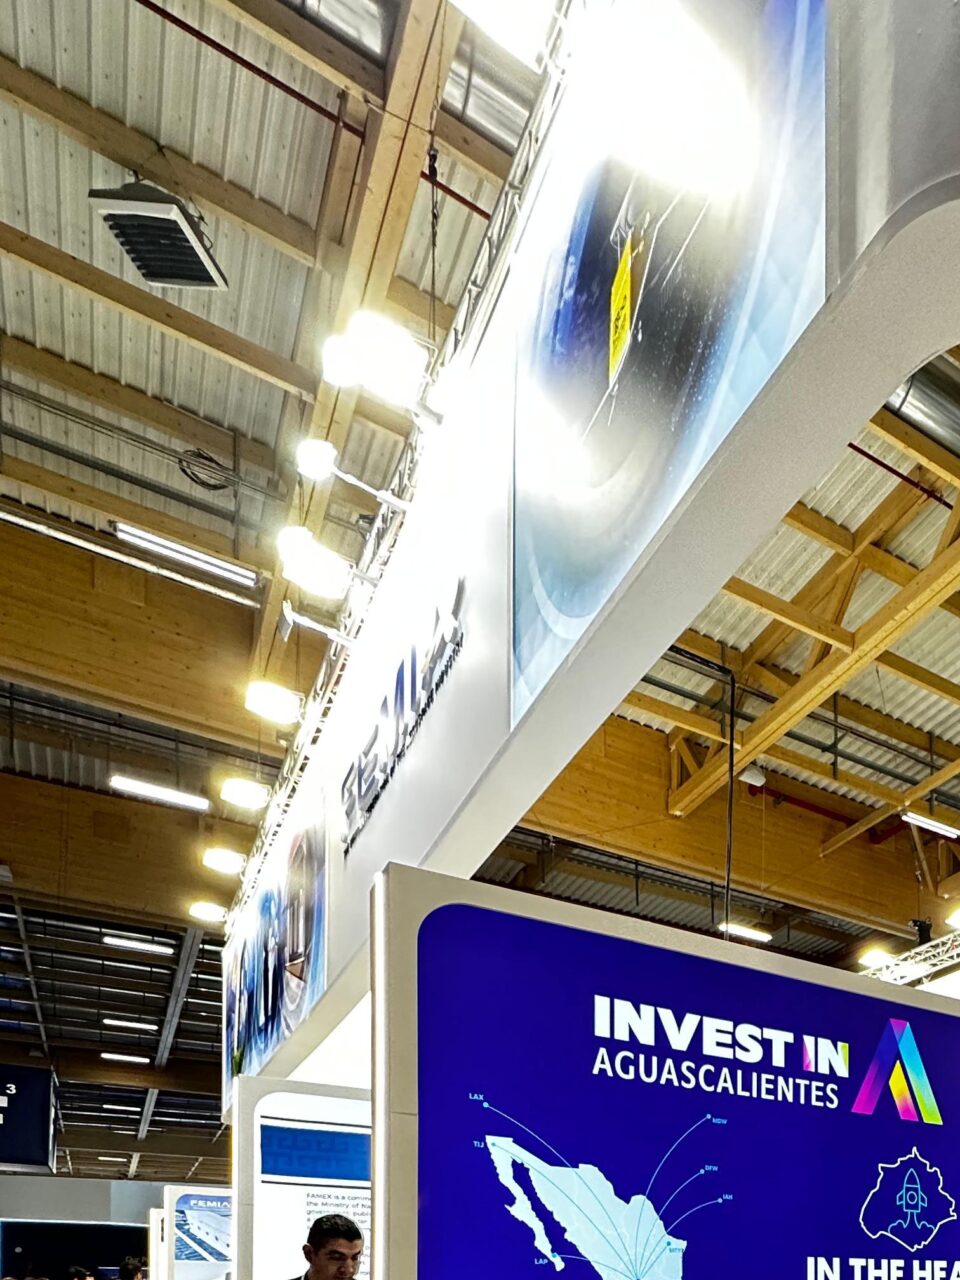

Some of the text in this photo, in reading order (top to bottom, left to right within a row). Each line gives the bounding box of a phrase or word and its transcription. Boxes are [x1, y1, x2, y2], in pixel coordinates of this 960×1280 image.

[594, 994, 849, 1078] INVEST IN
[591, 1046, 839, 1109] AGUASCALIENTES
[5, 1083, 17, 1094] 3
[469, 1092, 484, 1101] LAX
[473, 1140, 485, 1148] TIJ
